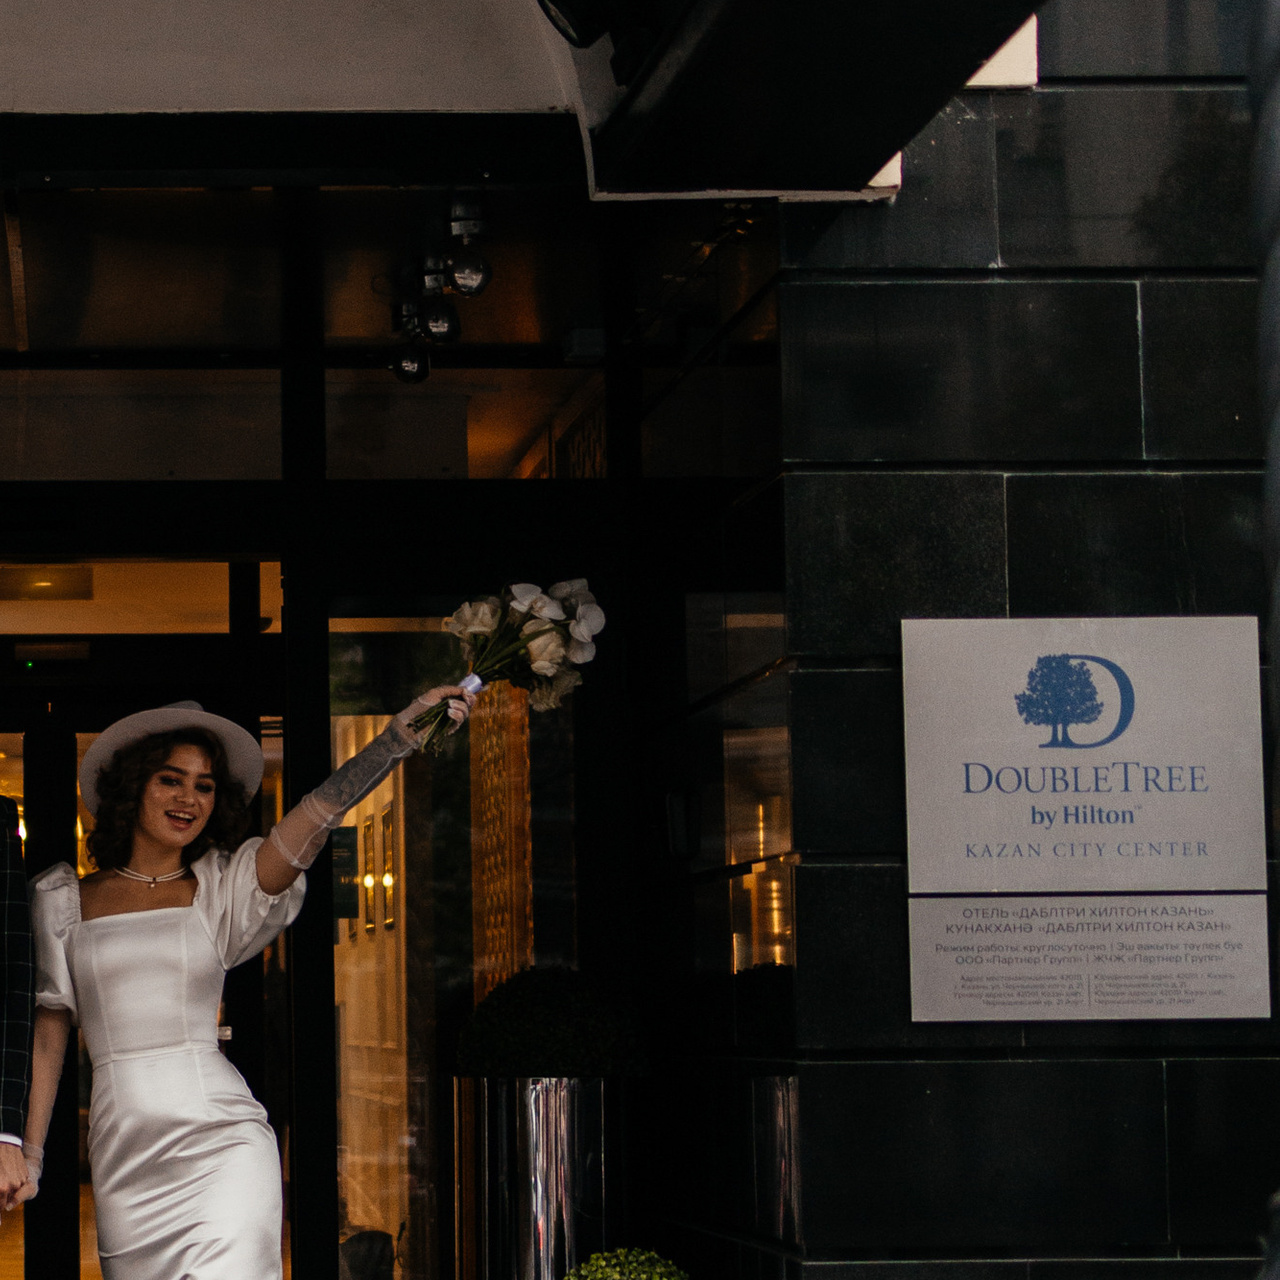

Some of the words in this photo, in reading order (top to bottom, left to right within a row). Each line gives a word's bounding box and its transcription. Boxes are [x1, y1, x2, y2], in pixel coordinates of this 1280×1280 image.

[1031, 805, 1057, 830] by
[966, 842, 1041, 858] KAZAN
[1053, 842, 1107, 858] CITY
[1117, 841, 1209, 857] CENTER
[962, 908, 1009, 919] ОТЕЛЬ
[1012, 907, 1085, 919] «ДАБЛТРИ
[1089, 906, 1147, 918] ХИЛТОН
[1150, 906, 1214, 917] КАЗАНЬ»
[1116, 921, 1173, 932] ХИЛТОН
